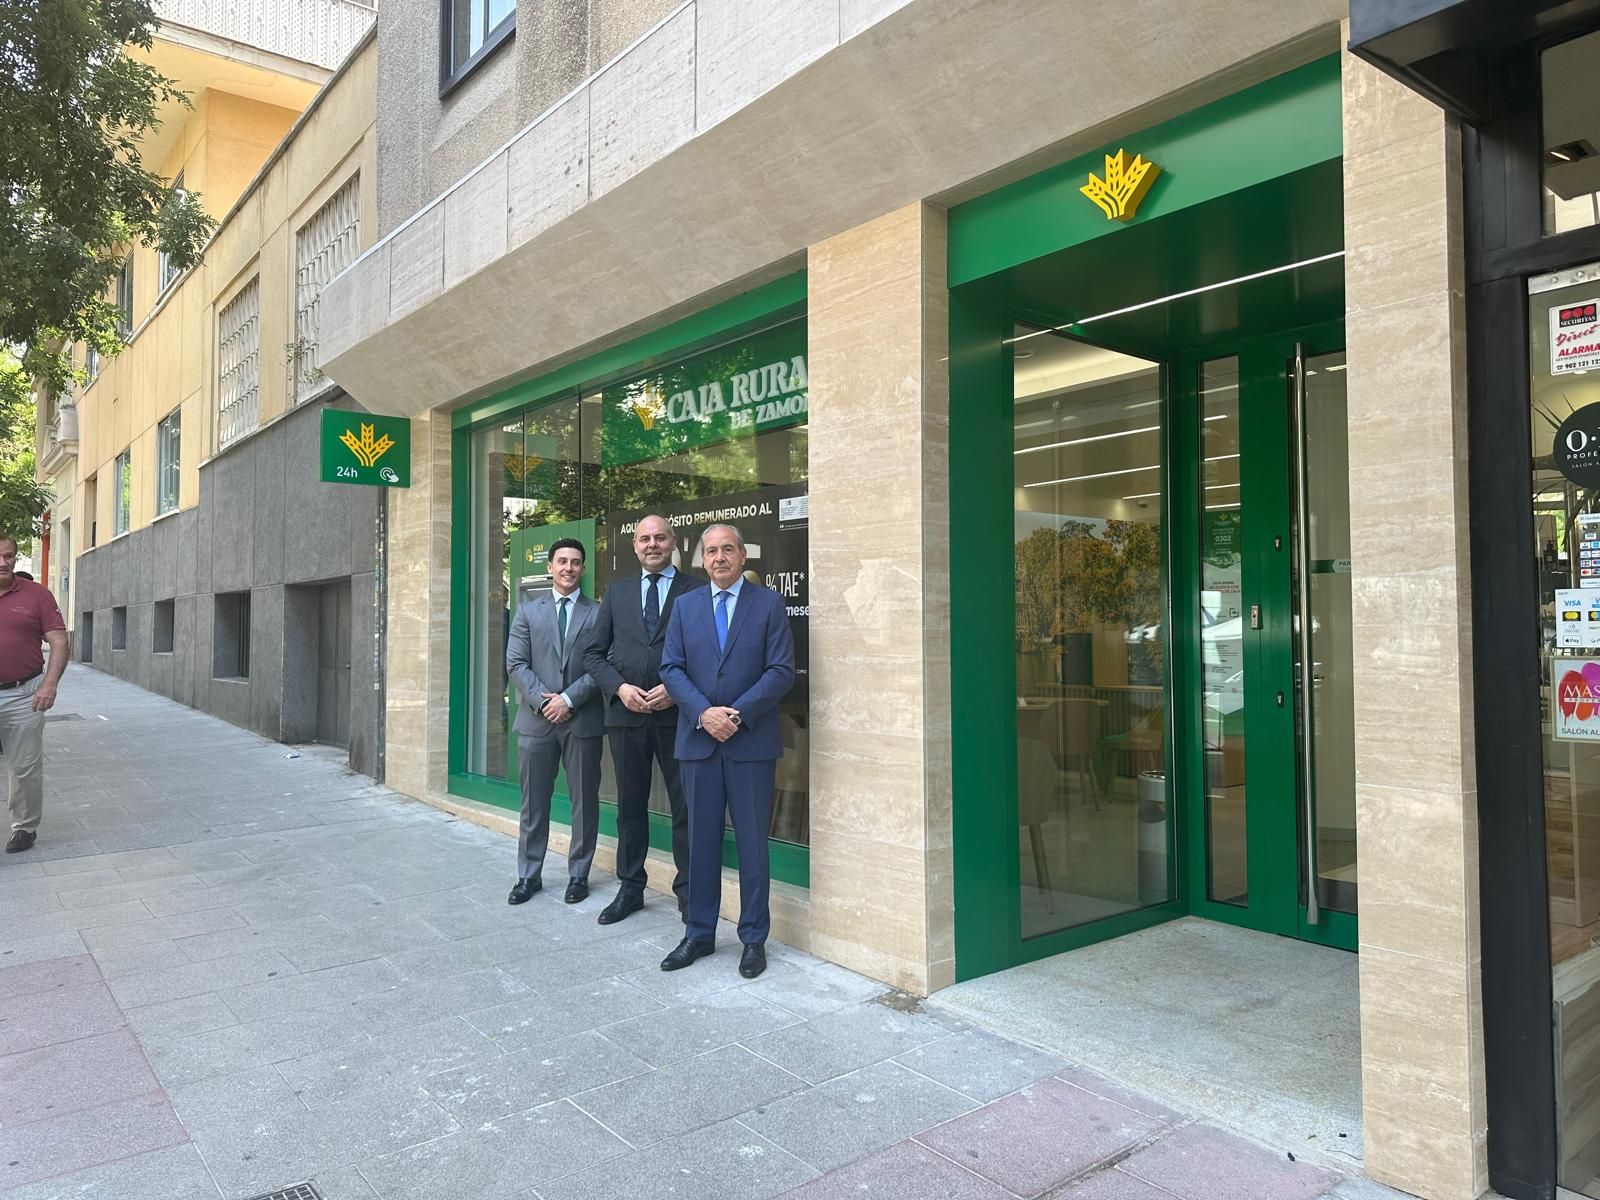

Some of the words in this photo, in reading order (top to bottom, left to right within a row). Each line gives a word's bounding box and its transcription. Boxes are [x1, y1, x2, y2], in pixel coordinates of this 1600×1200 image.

[1560, 316, 1596, 326] SECURITAS
[1556, 324, 1600, 346] Direct
[1558, 343, 1600, 357] ALARMA
[667, 382, 728, 424] CAJA
[336, 466, 358, 478] 24h
[665, 513, 693, 528] ÓSITO
[694, 505, 757, 525] REMUNERADO
[758, 502, 773, 516] AL
[1564, 684, 1600, 699] MAS
